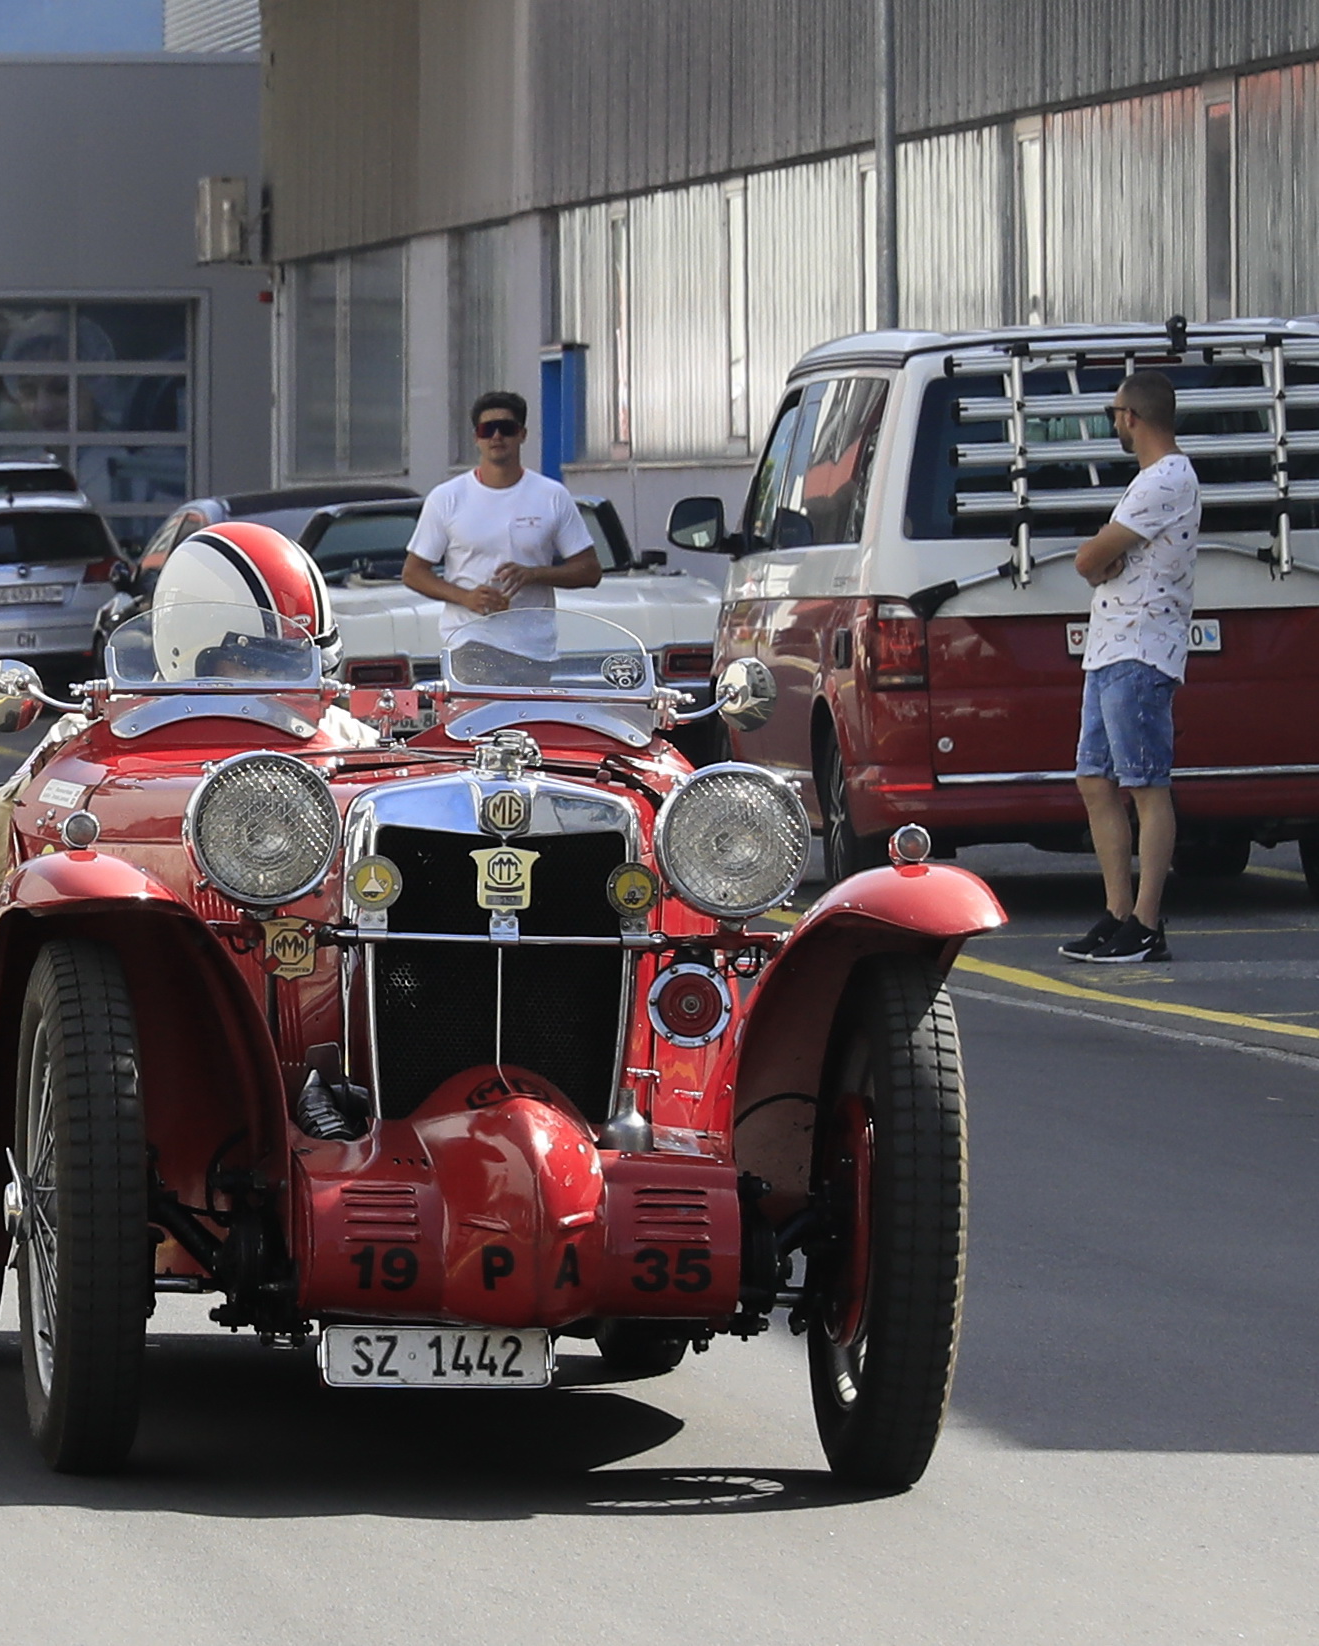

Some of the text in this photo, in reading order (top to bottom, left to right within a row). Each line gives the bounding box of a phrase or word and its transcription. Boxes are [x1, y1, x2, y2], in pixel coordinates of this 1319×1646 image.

[17, 632, 37, 648] CH
[492, 795, 522, 826] MG
[350, 1243, 712, 1294] 19 P A 35
[351, 1335, 525, 1378] SZ 1442
